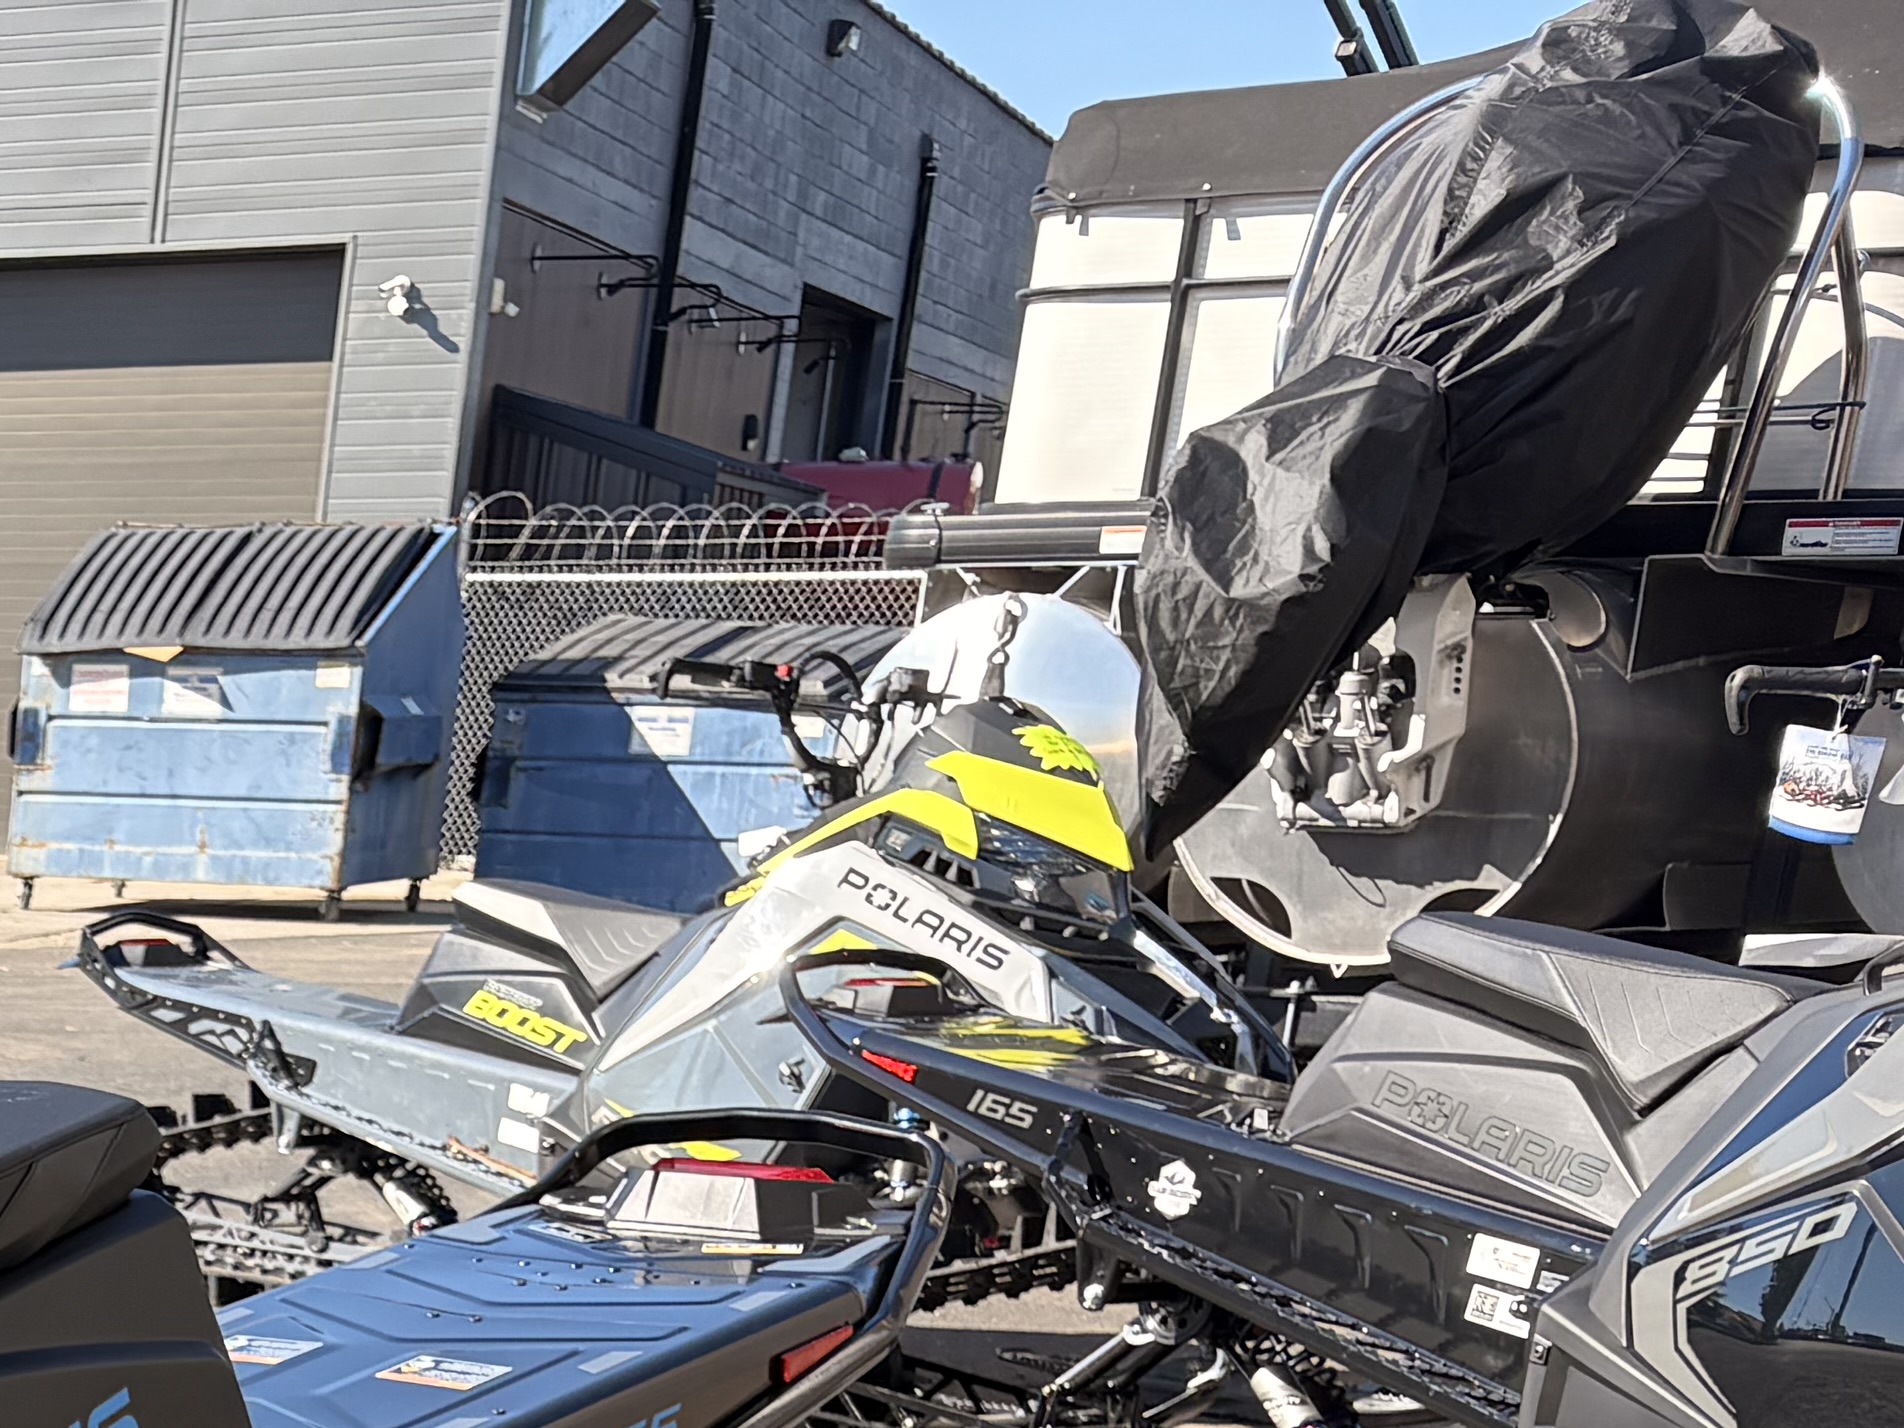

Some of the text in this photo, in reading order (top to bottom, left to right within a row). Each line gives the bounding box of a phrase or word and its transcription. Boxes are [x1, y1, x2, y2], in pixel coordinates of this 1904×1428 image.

[837, 867, 1011, 970] POLARIS
[463, 989, 588, 1054] BOOST
[966, 1088, 1039, 1129] 165
[1371, 1070, 1611, 1198] POLARIS
[1676, 1201, 1858, 1300] 850
